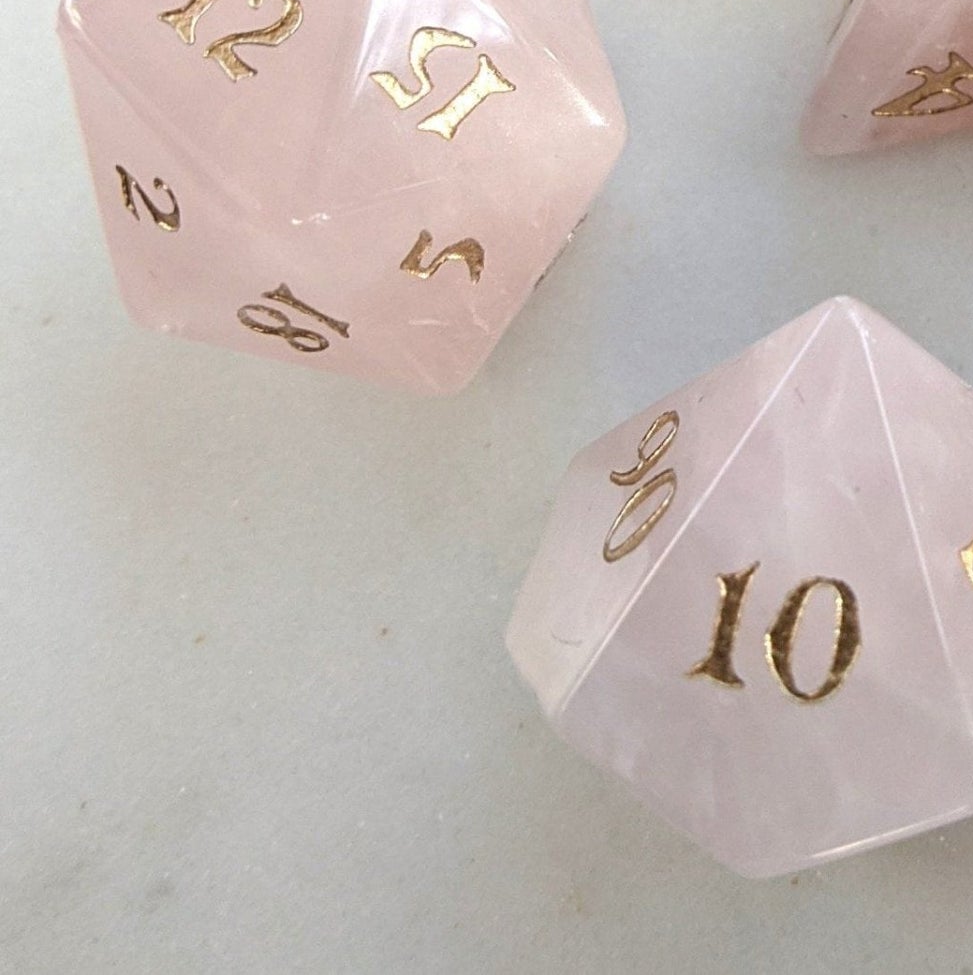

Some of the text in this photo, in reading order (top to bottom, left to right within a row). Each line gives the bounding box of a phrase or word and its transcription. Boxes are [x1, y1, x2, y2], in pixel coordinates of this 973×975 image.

[371, 26, 516, 140] 15
[115, 164, 180, 232] 2
[400, 229, 485, 284] 5
[237, 283, 350, 352] 18
[603, 410, 679, 562] 90
[686, 561, 862, 705] 10
